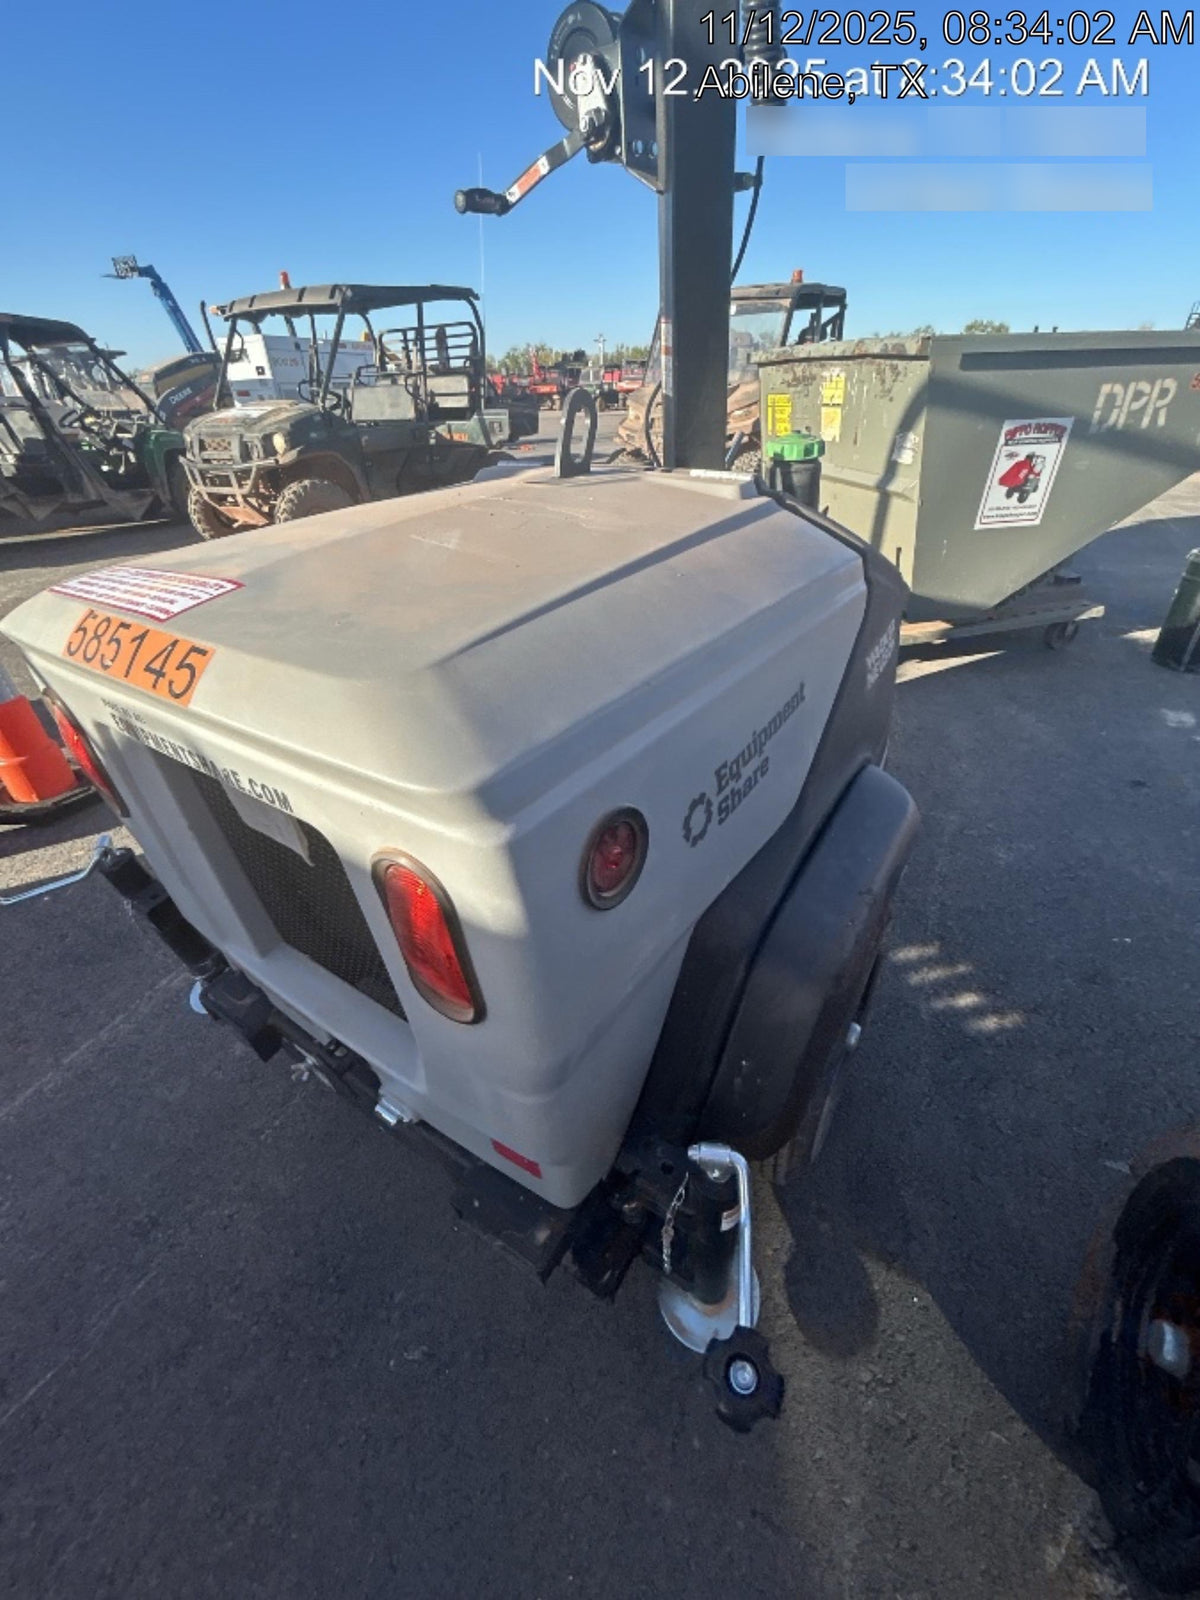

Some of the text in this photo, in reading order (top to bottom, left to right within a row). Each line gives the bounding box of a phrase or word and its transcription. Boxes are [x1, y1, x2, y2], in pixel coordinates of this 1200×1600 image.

[1089, 378, 1178, 433] DPR
[66, 608, 208, 699] 585145
[714, 681, 806, 796] Equipment
[717, 756, 770, 826] Share
